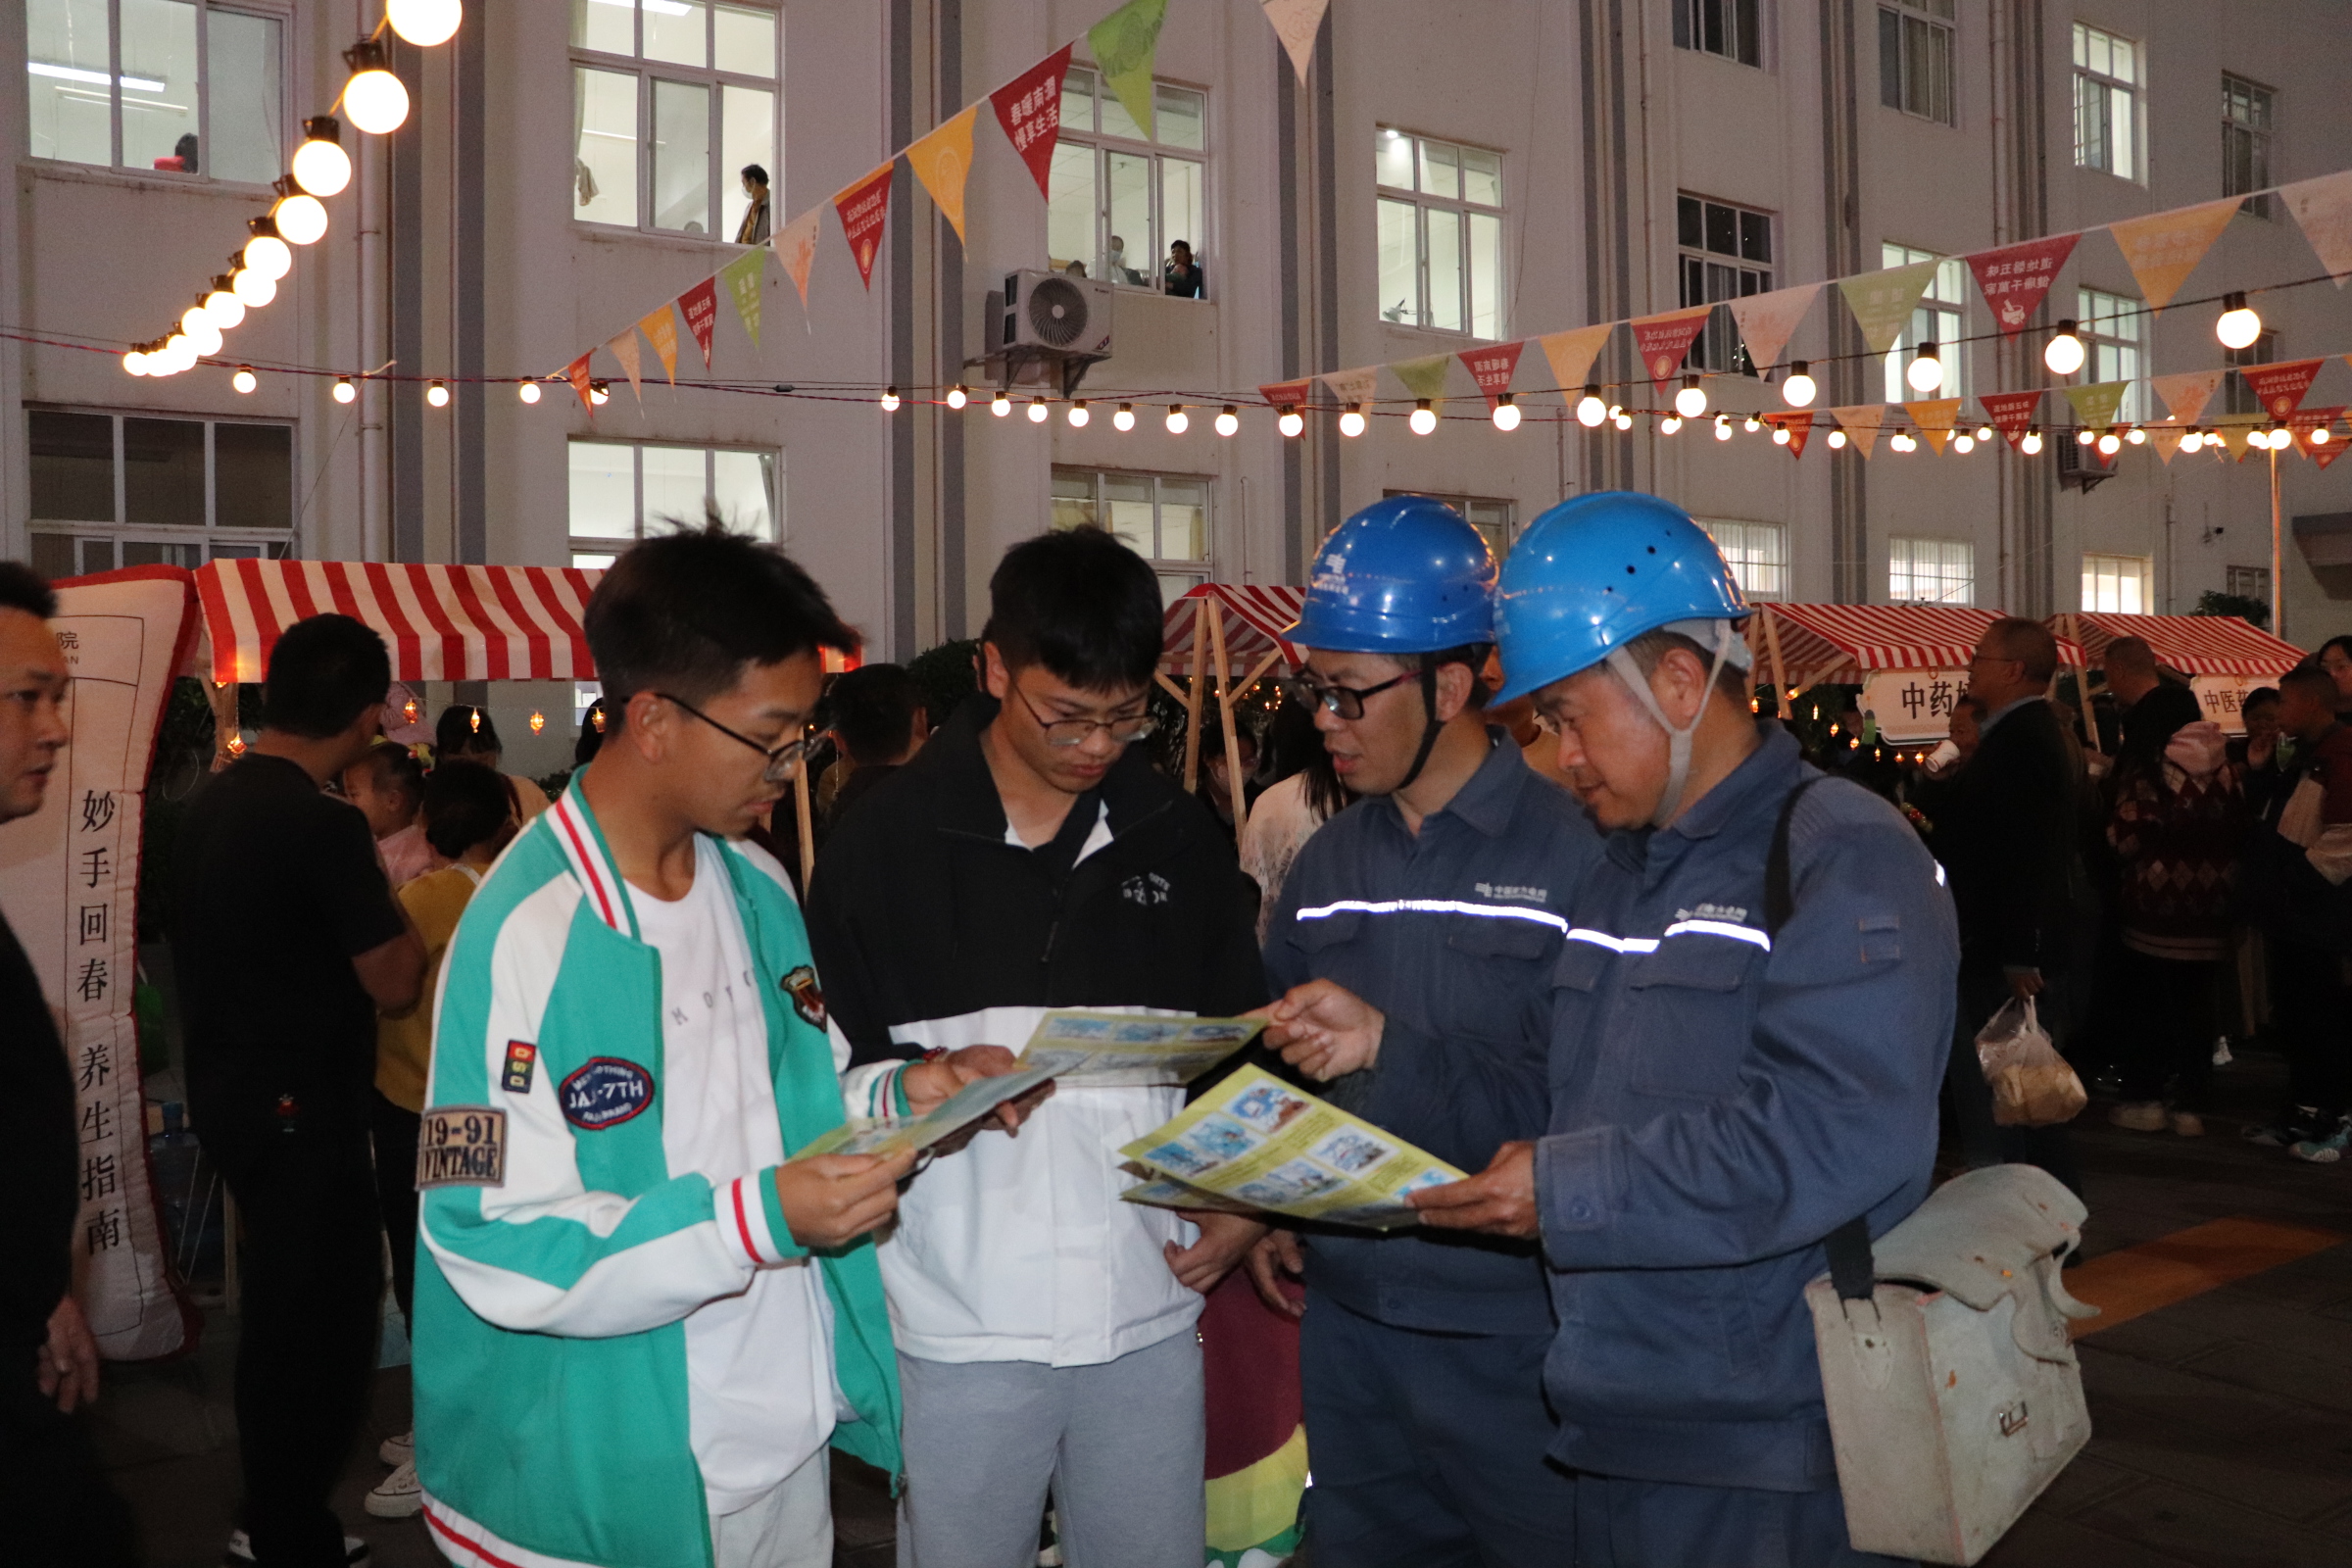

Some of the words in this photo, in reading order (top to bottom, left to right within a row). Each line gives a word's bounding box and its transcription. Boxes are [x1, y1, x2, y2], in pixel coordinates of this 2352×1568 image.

[1902, 680, 1968, 720] 中药
[76, 789, 116, 1003] 妙手回春
[78, 1043, 121, 1256] 养生指南
[424, 1115, 497, 1147] 19-91
[423, 1146, 498, 1180] VINTAGE
